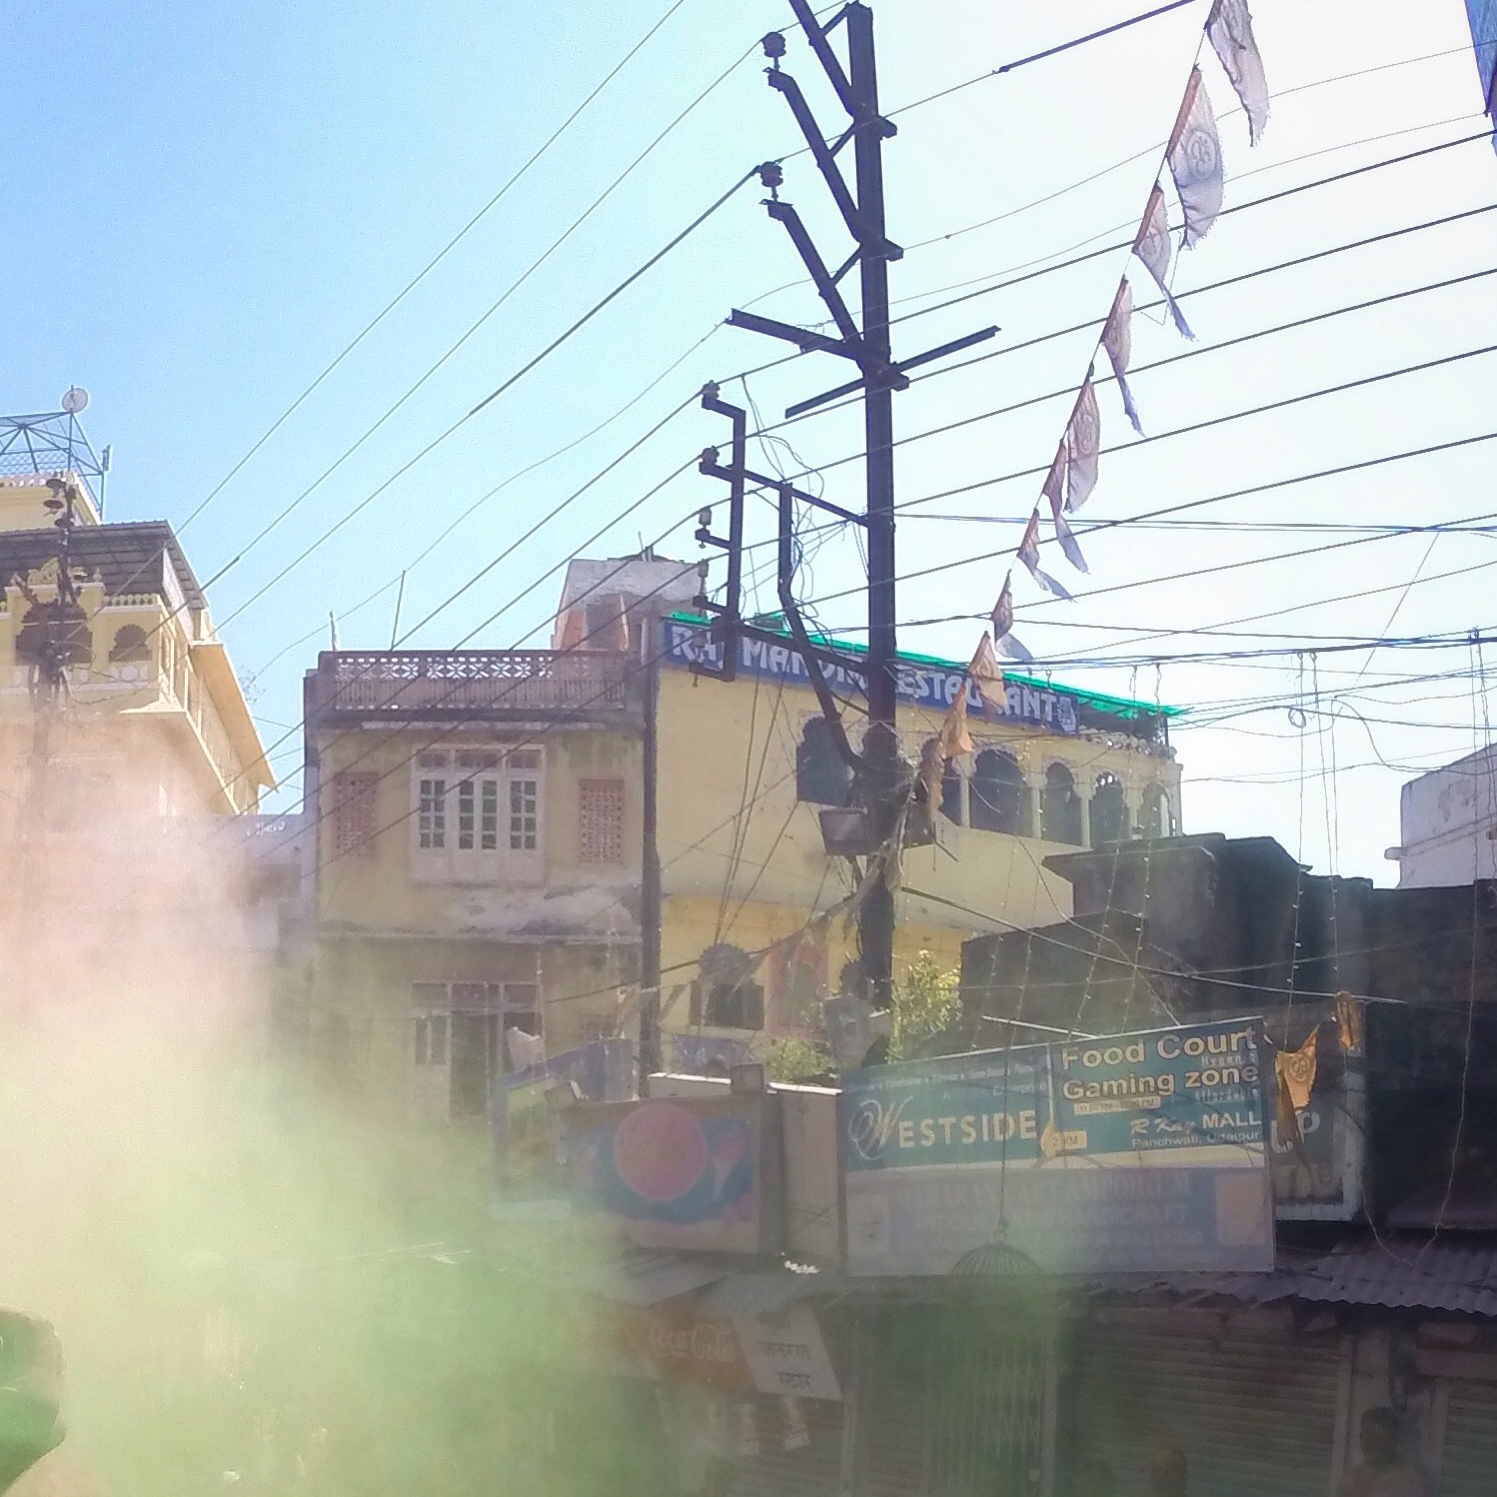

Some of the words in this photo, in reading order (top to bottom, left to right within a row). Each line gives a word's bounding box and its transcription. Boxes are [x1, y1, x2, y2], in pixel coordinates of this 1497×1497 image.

[1061, 1038, 1146, 1071] Food
[1156, 1026, 1258, 1060] Court
[1062, 1072, 1175, 1101] Gaming
[1184, 1065, 1259, 1089] zone
[848, 1095, 1038, 1161] WESTSIDE
[1202, 1110, 1262, 1129] MALL
